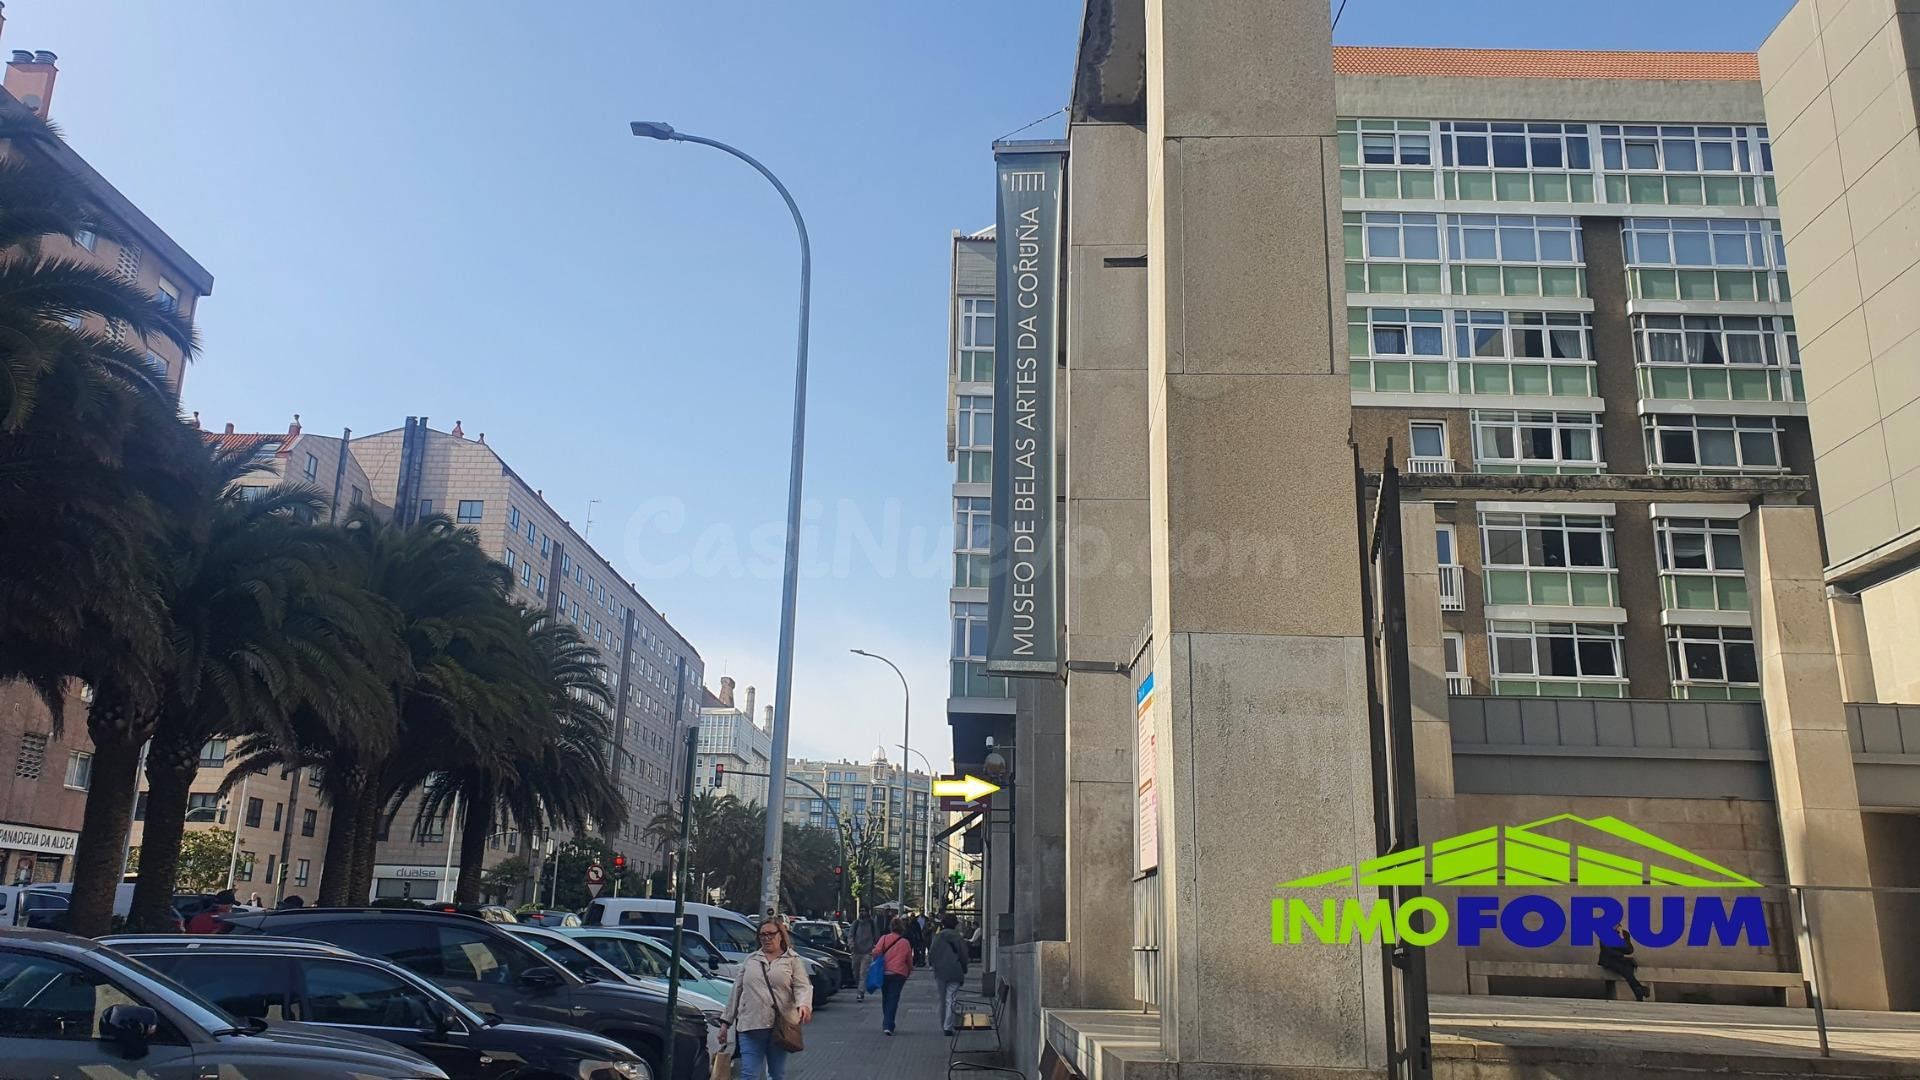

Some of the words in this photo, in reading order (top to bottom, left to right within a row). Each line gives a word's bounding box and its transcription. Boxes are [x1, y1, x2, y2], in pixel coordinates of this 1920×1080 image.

[1016, 206, 1040, 309] CORUÑA
[1017, 315, 1038, 350] DA
[1016, 357, 1037, 431] ARTES
[1015, 438, 1036, 512] BELAS
[1014, 519, 1035, 553] DE
[1013, 561, 1035, 656] MUSEO
[40, 834, 50, 848] DA
[51, 835, 74, 850] ALDEA
